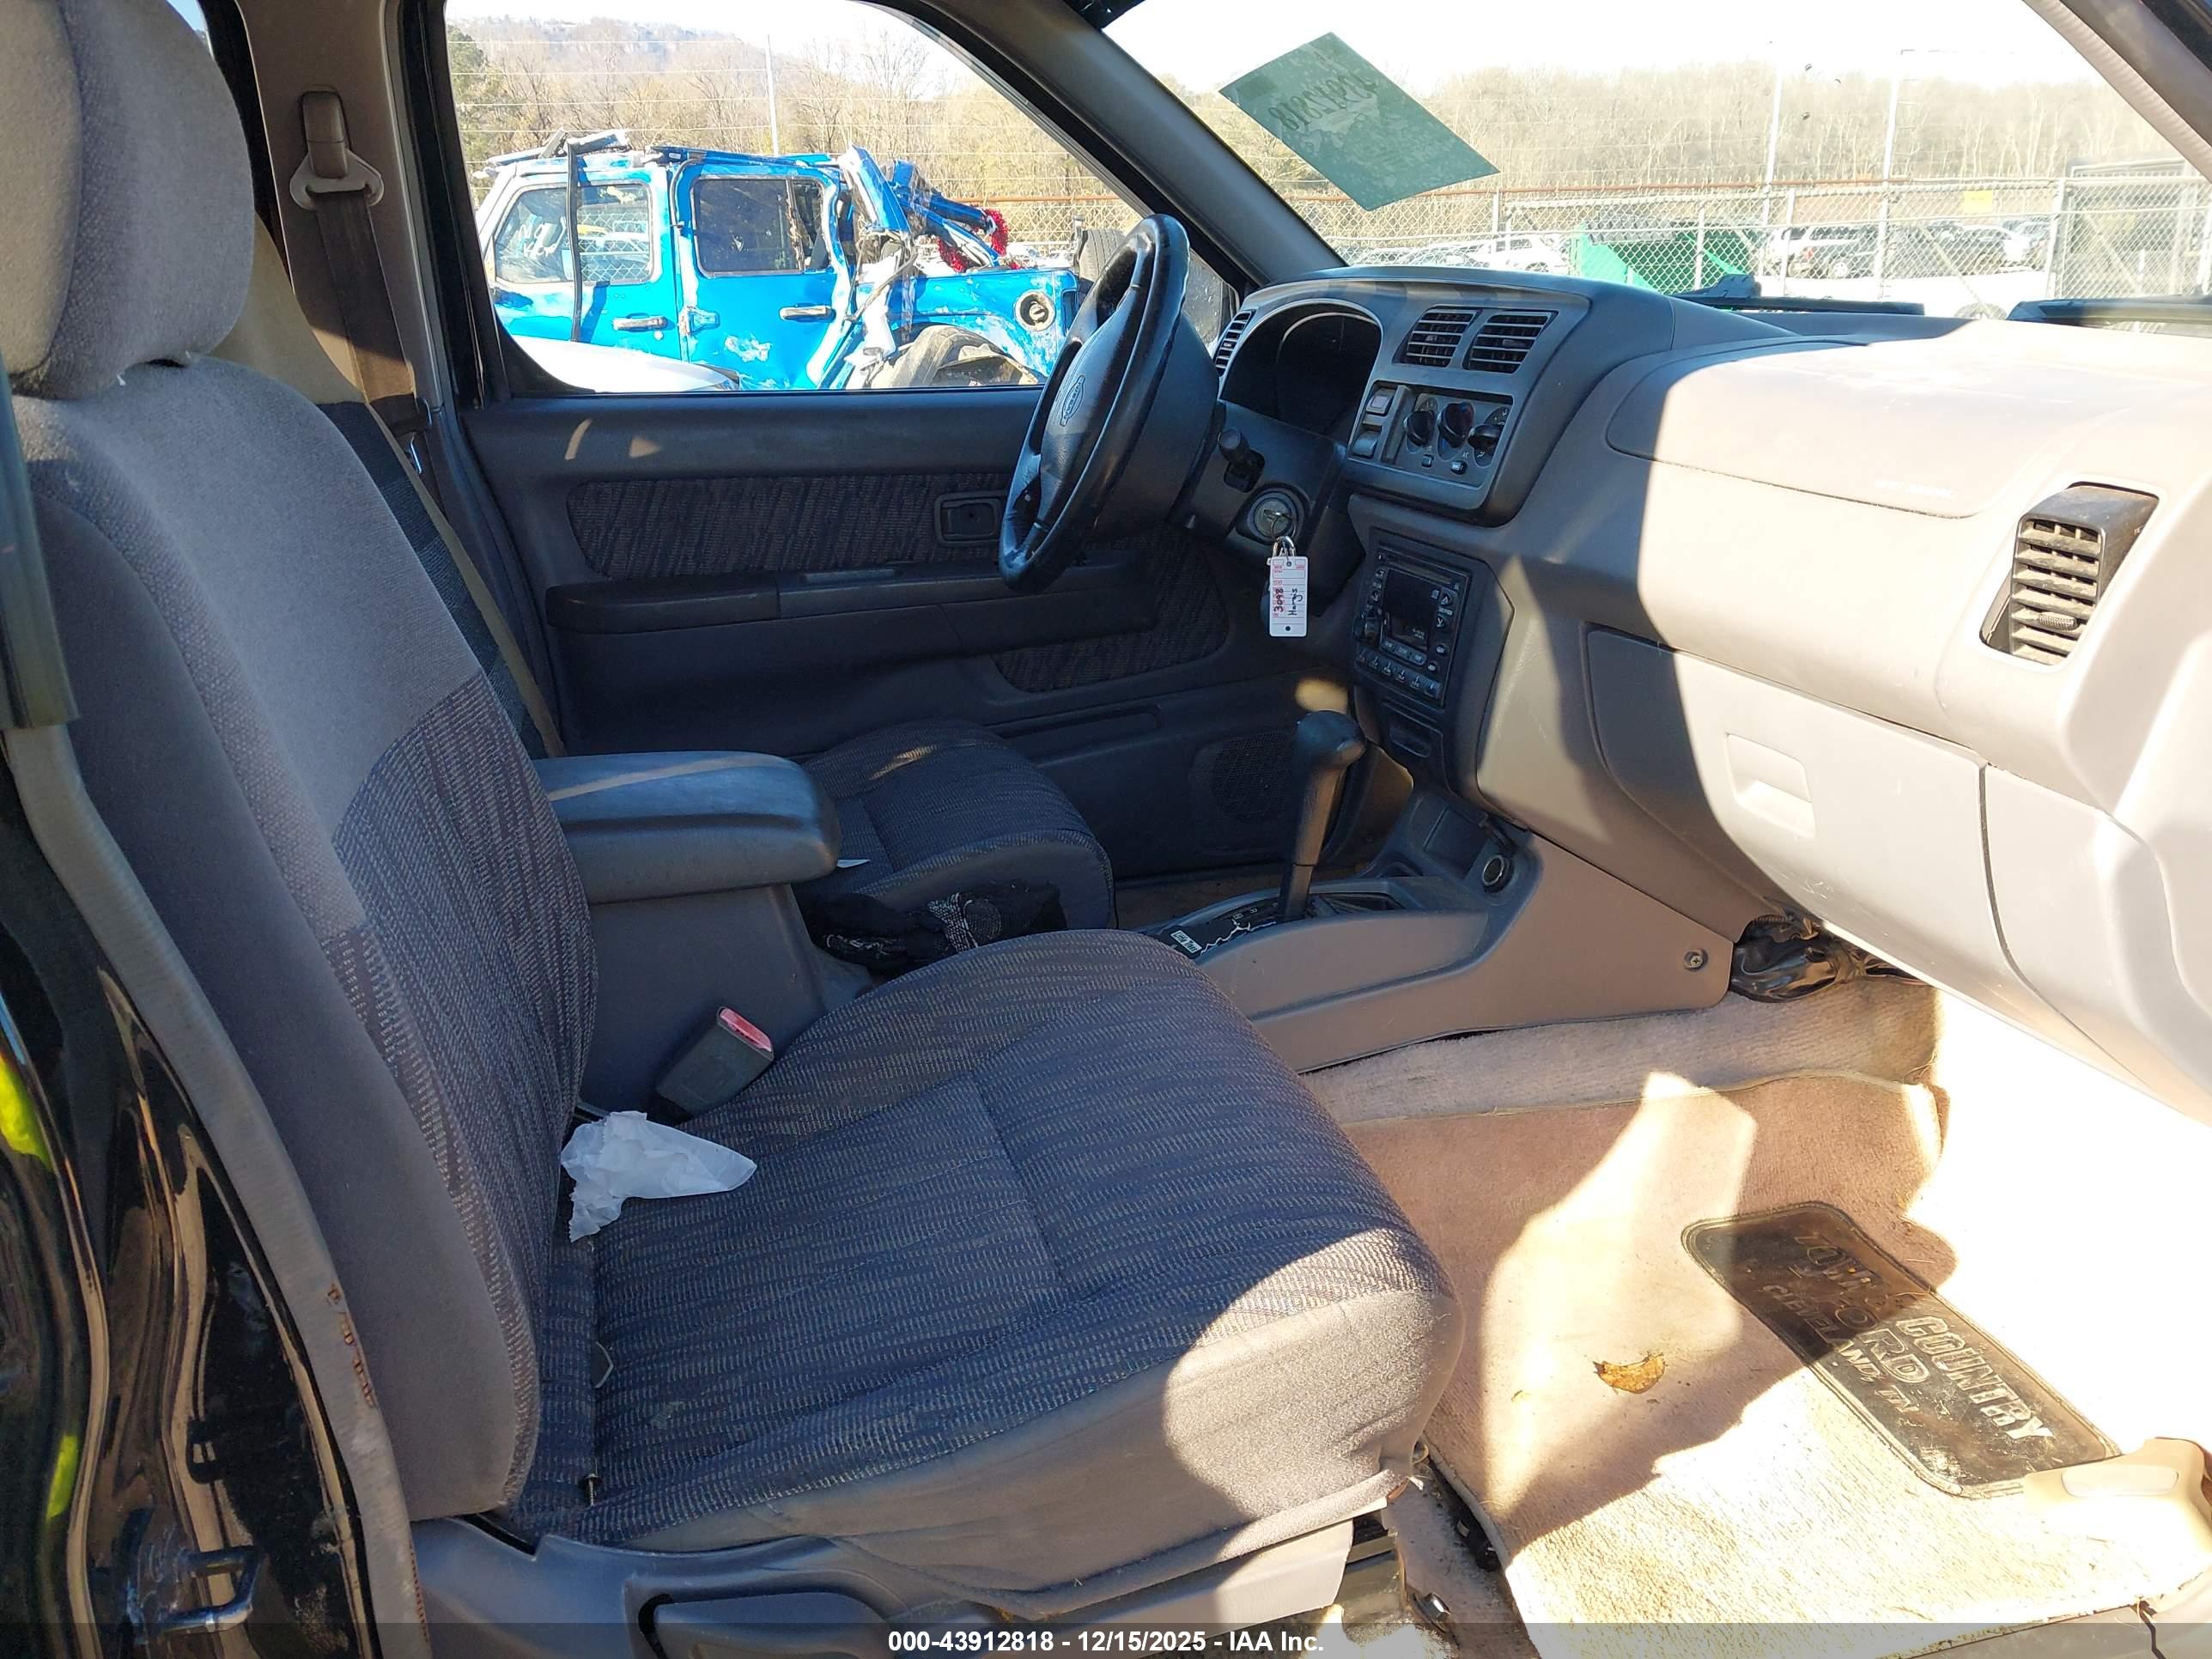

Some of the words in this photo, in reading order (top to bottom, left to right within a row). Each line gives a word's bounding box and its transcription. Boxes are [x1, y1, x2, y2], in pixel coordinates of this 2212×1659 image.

[1273, 588, 1284, 613] 3098
[1895, 1316, 2055, 1439] COUNTRY
[1875, 1384, 1920, 1413] TN
